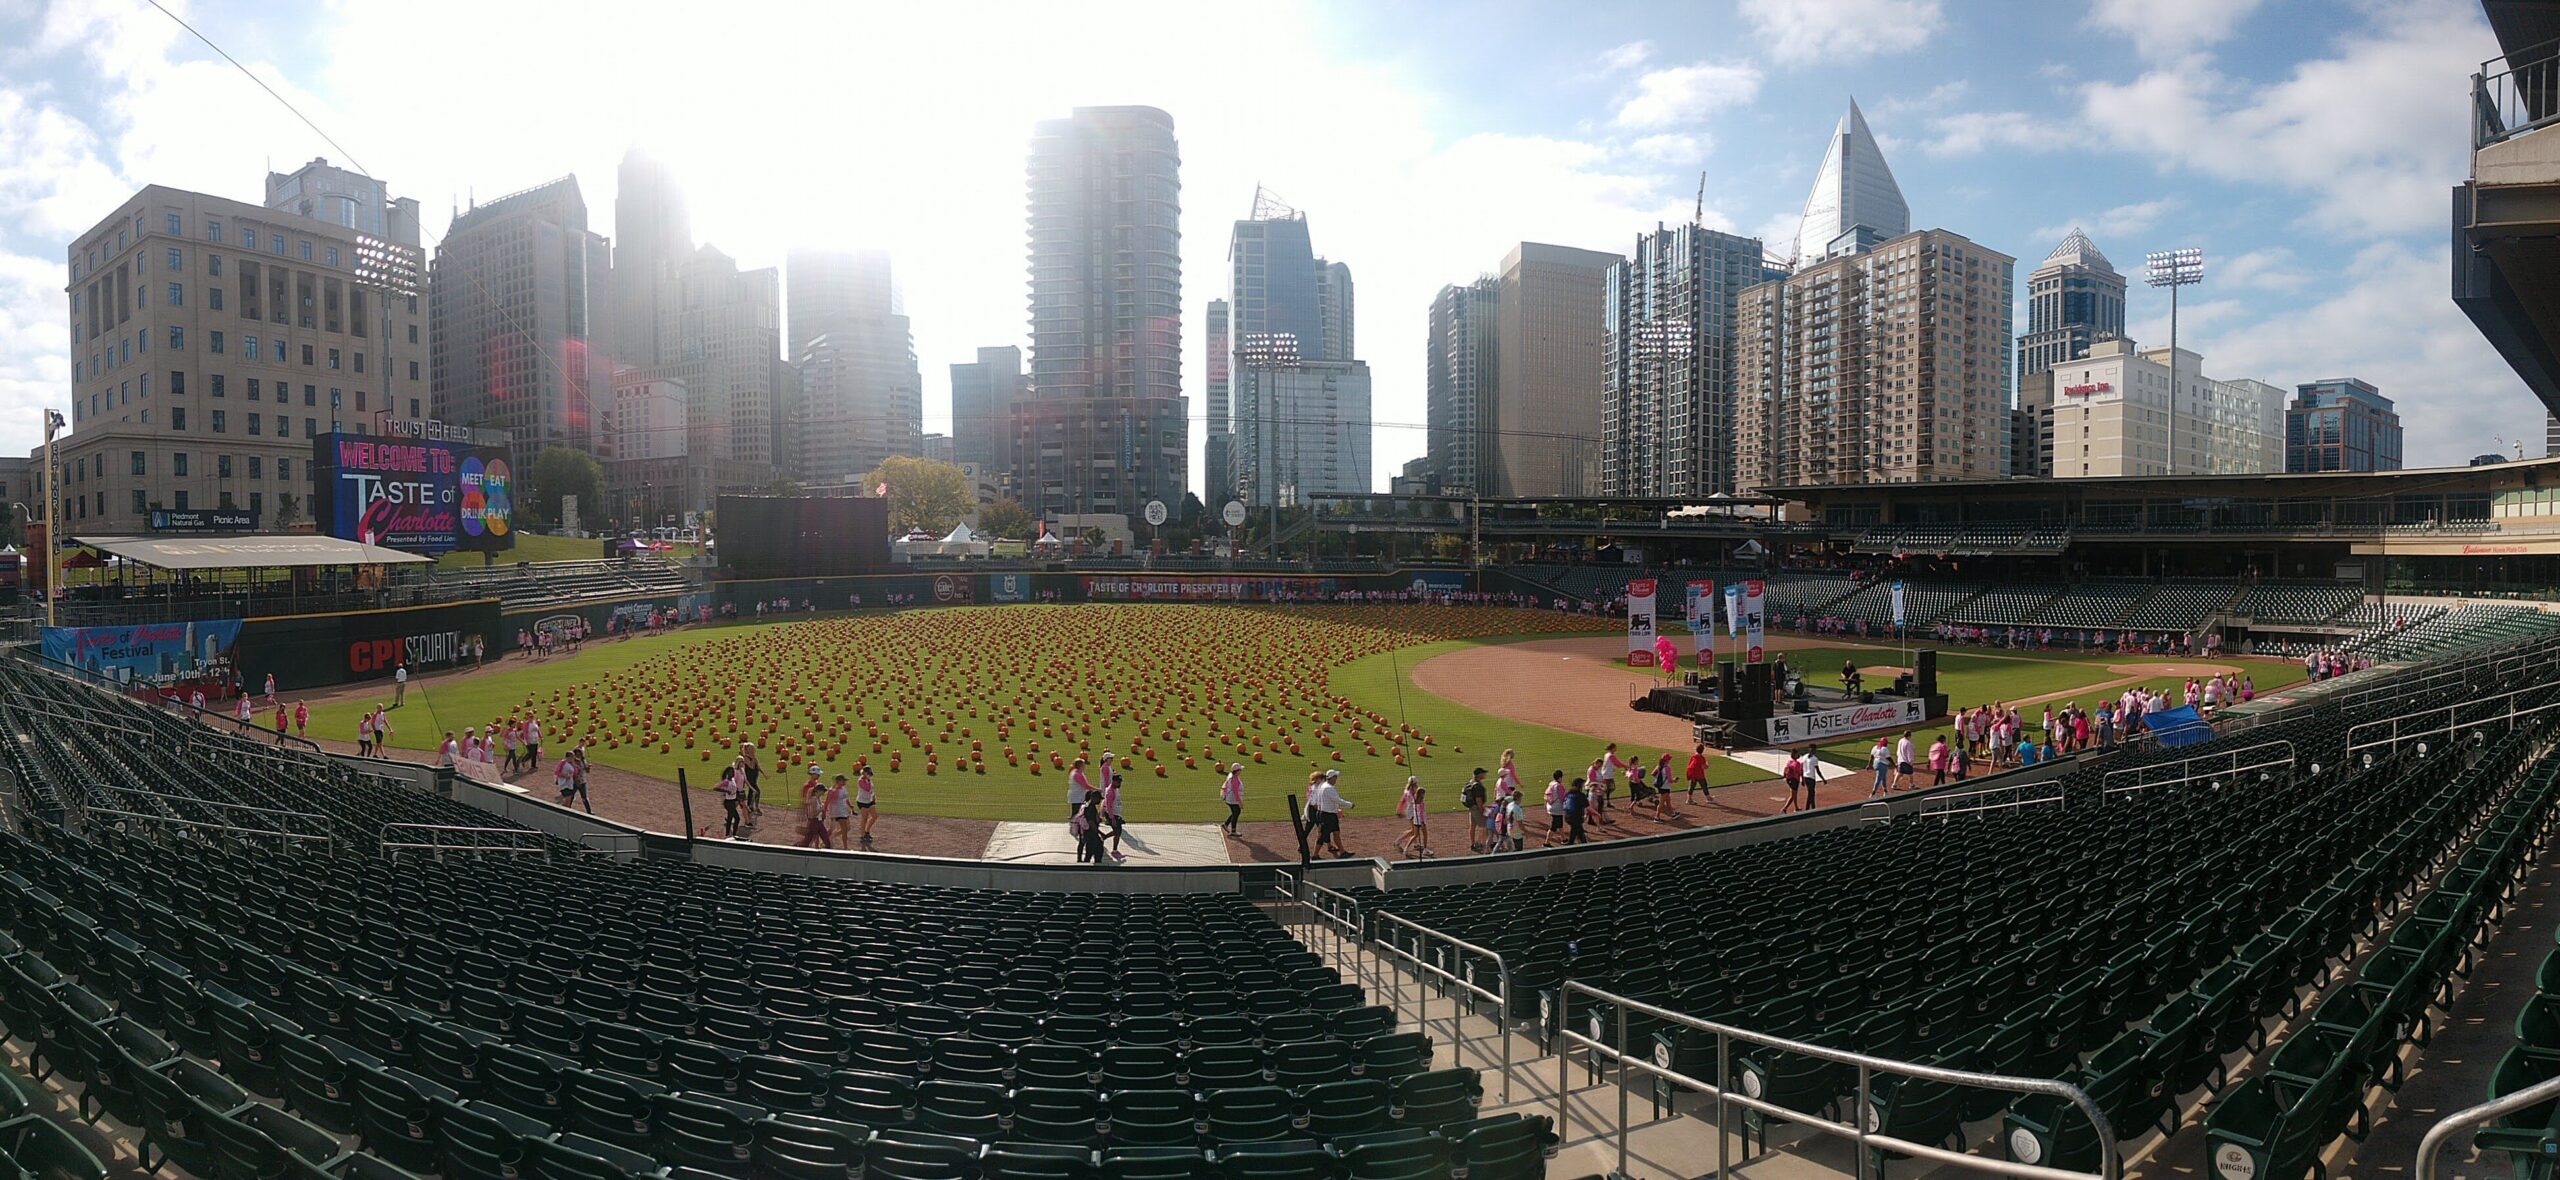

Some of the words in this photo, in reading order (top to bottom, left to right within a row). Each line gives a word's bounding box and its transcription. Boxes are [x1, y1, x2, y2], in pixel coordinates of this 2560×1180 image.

[2064, 384, 2096, 396] Residence
[2097, 382, 2110, 392] Inn
[385, 419, 426, 435] TRUIST
[443, 425, 469, 439] FIELD
[51, 445, 59, 474] EAT
[339, 441, 428, 473] WELCOME
[431, 449, 455, 474] TO:
[462, 473, 484, 486] MEET
[490, 475, 506, 486] EAT
[51, 479, 60, 510] MOR
[342, 473, 435, 522] TASTE
[441, 486, 455, 504] of
[213, 515, 233, 524] Picnic
[234, 516, 250, 524] Area
[358, 498, 455, 545] Charlotte
[461, 508, 486, 520] DRINK
[487, 508, 510, 520] PLAY
[52, 517, 61, 554] FOWL
[386, 535, 417, 544] Presented
[417, 536, 427, 544] by
[1089, 581, 1117, 593] TASTE
[1118, 583, 1130, 592] OF
[1131, 582, 1178, 593] CHARLOTTE
[1180, 583, 1229, 593] PRESENTED
[1230, 583, 1243, 593] BY
[120, 631, 130, 644] of
[102, 643, 154, 660] Festival
[350, 637, 404, 672] CPI
[194, 658, 218, 669] Tryon
[219, 657, 231, 665] St.
[152, 673, 176, 683] June
[179, 670, 201, 680] 10th
[1802, 714, 1842, 735] TASTE
[1843, 716, 1850, 724] of
[1851, 704, 1897, 726] Charlotte
[1825, 726, 1849, 734] Presented
